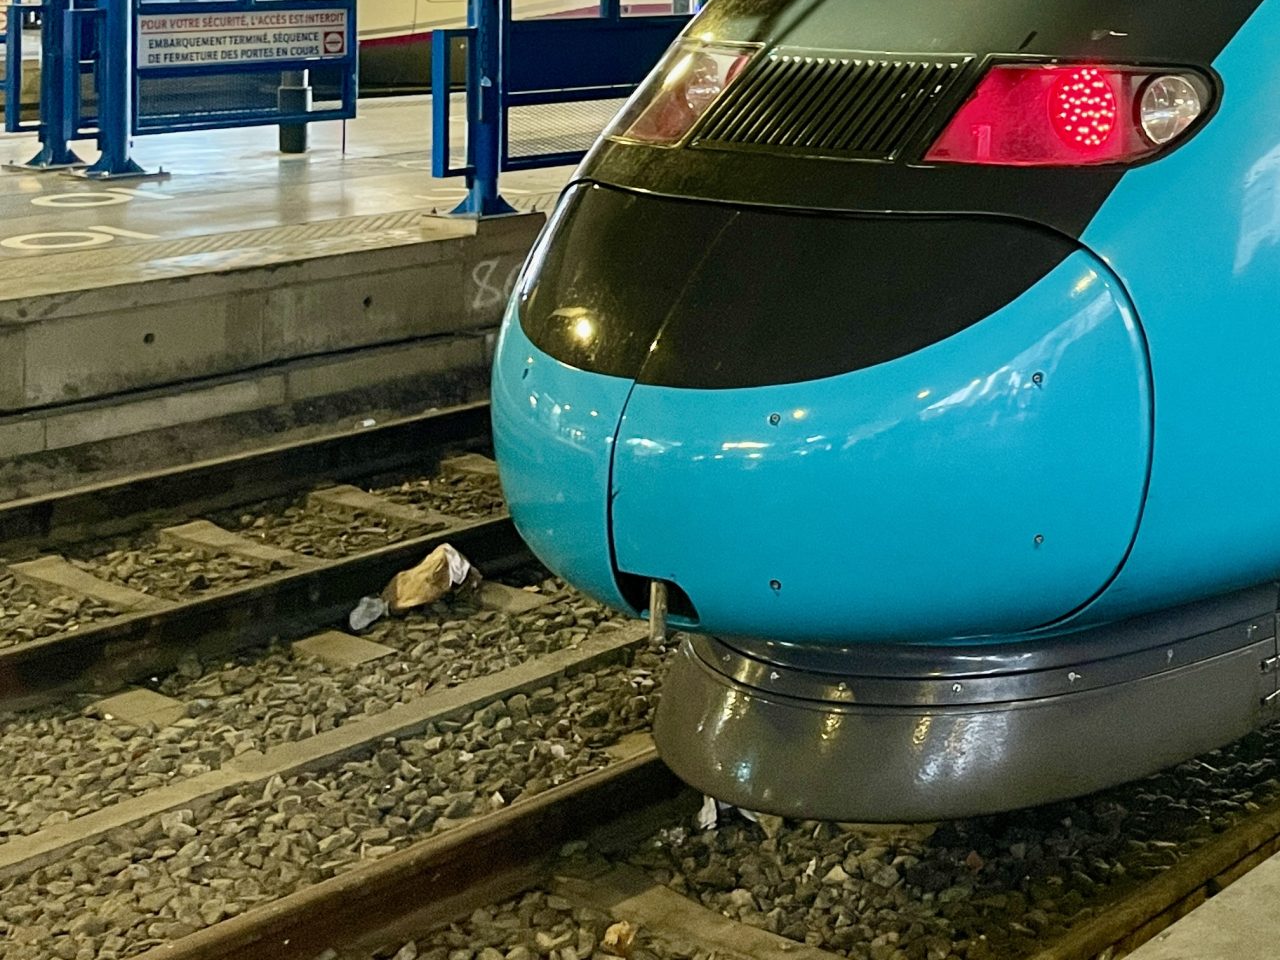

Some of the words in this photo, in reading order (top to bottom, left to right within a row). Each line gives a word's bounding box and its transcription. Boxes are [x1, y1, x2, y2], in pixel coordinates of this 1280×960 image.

[141, 17, 167, 30] POUR
[170, 15, 200, 29] VOTRE
[202, 14, 249, 29] SÉCURITÉ,
[251, 12, 287, 26] L'ACCÈS
[289, 13, 304, 25] EST
[305, 12, 344, 24] INTERDIT
[148, 36, 228, 49] EMBARQUEMENT
[229, 33, 271, 46] TERMINÉ,
[272, 31, 320, 44] SÉQUENCE
[148, 53, 161, 64] DE
[163, 50, 218, 62] FERMETURE
[221, 49, 238, 60] DES
[240, 48, 274, 59] PORTES
[276, 47, 288, 57] EN
[290, 45, 320, 56] COURS
